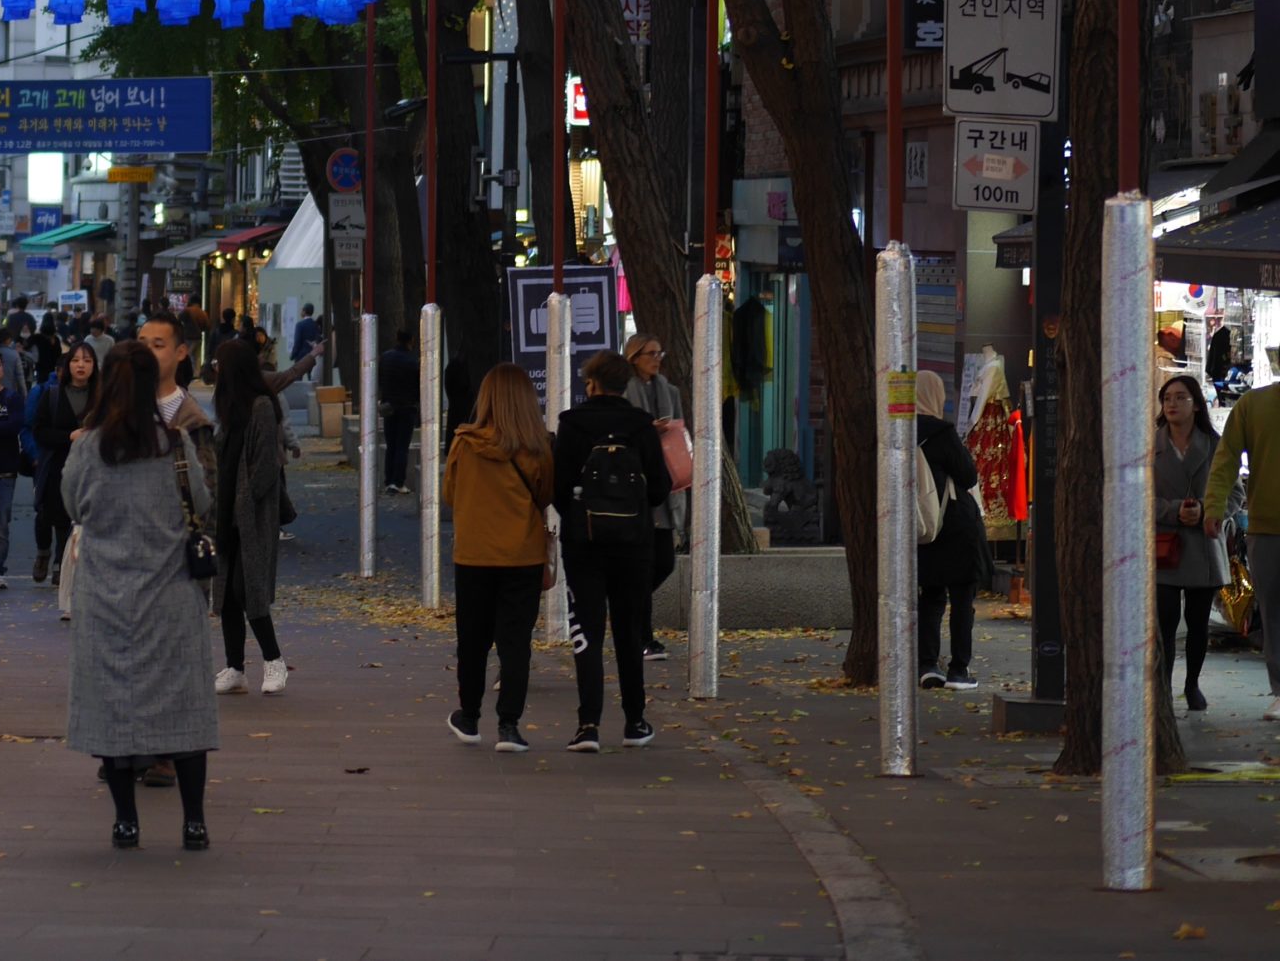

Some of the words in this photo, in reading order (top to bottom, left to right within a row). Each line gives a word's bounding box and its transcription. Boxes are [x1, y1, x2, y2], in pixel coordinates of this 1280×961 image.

[17, 88, 49, 110] 고개
[54, 88, 85, 110] 고개
[90, 85, 120, 113] 넘어
[967, 129, 1028, 152] 구간내
[973, 185, 1020, 203] 100m
